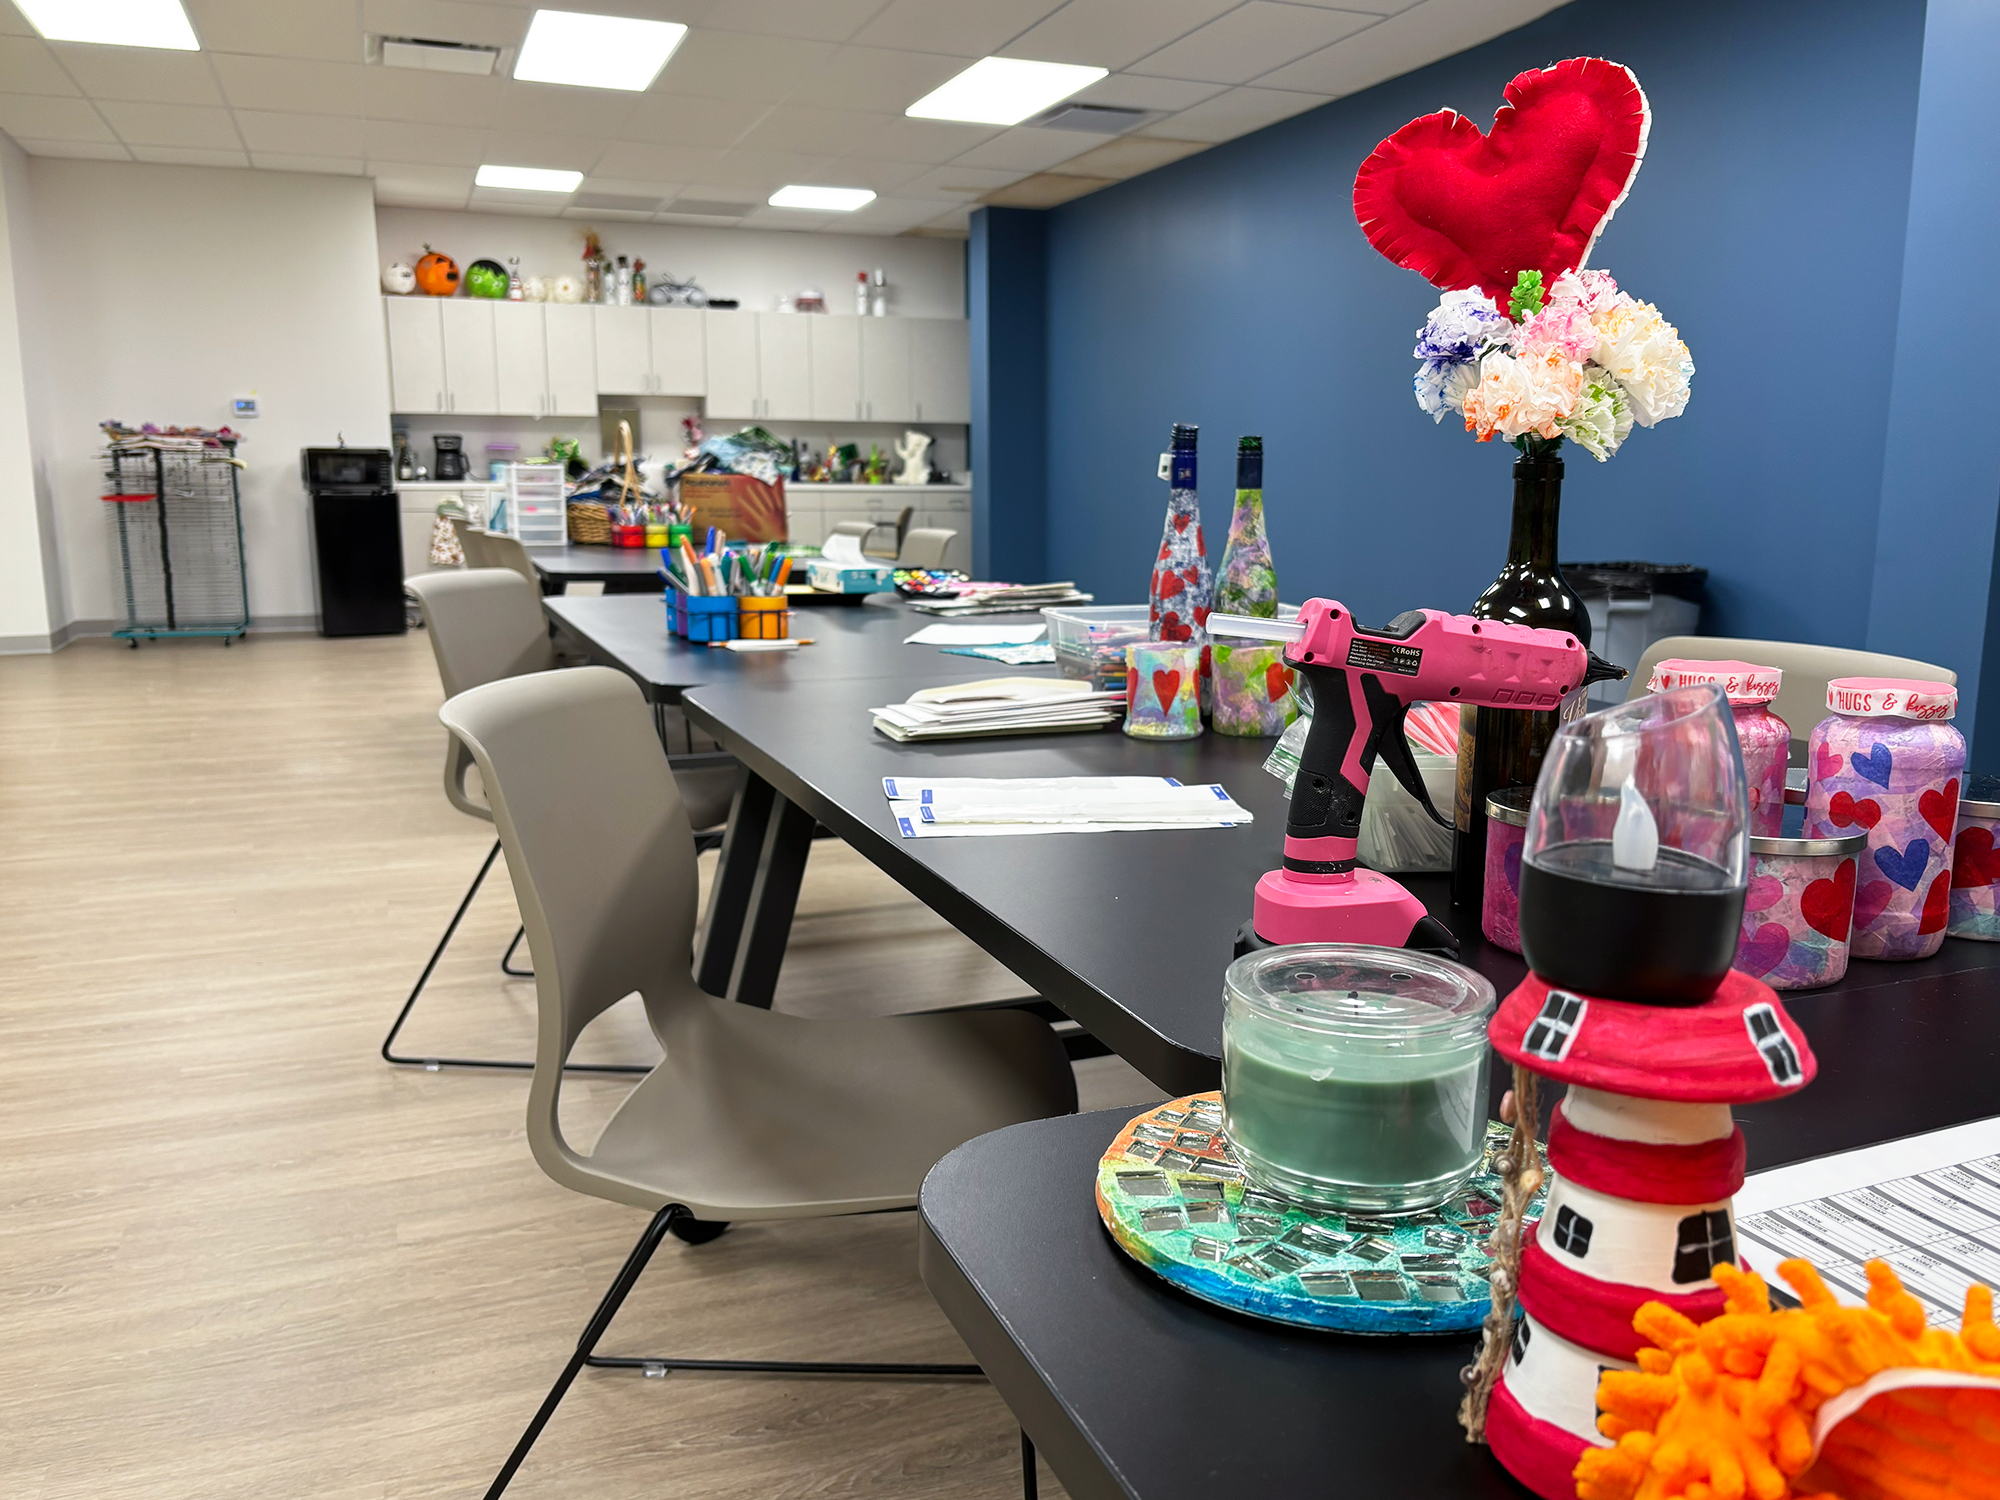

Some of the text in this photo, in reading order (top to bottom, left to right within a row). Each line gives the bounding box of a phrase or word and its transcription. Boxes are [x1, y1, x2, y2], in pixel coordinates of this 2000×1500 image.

[1726, 676, 1739, 694] &
[1838, 691, 1872, 712] HUGS
[1882, 693, 1898, 710] &
